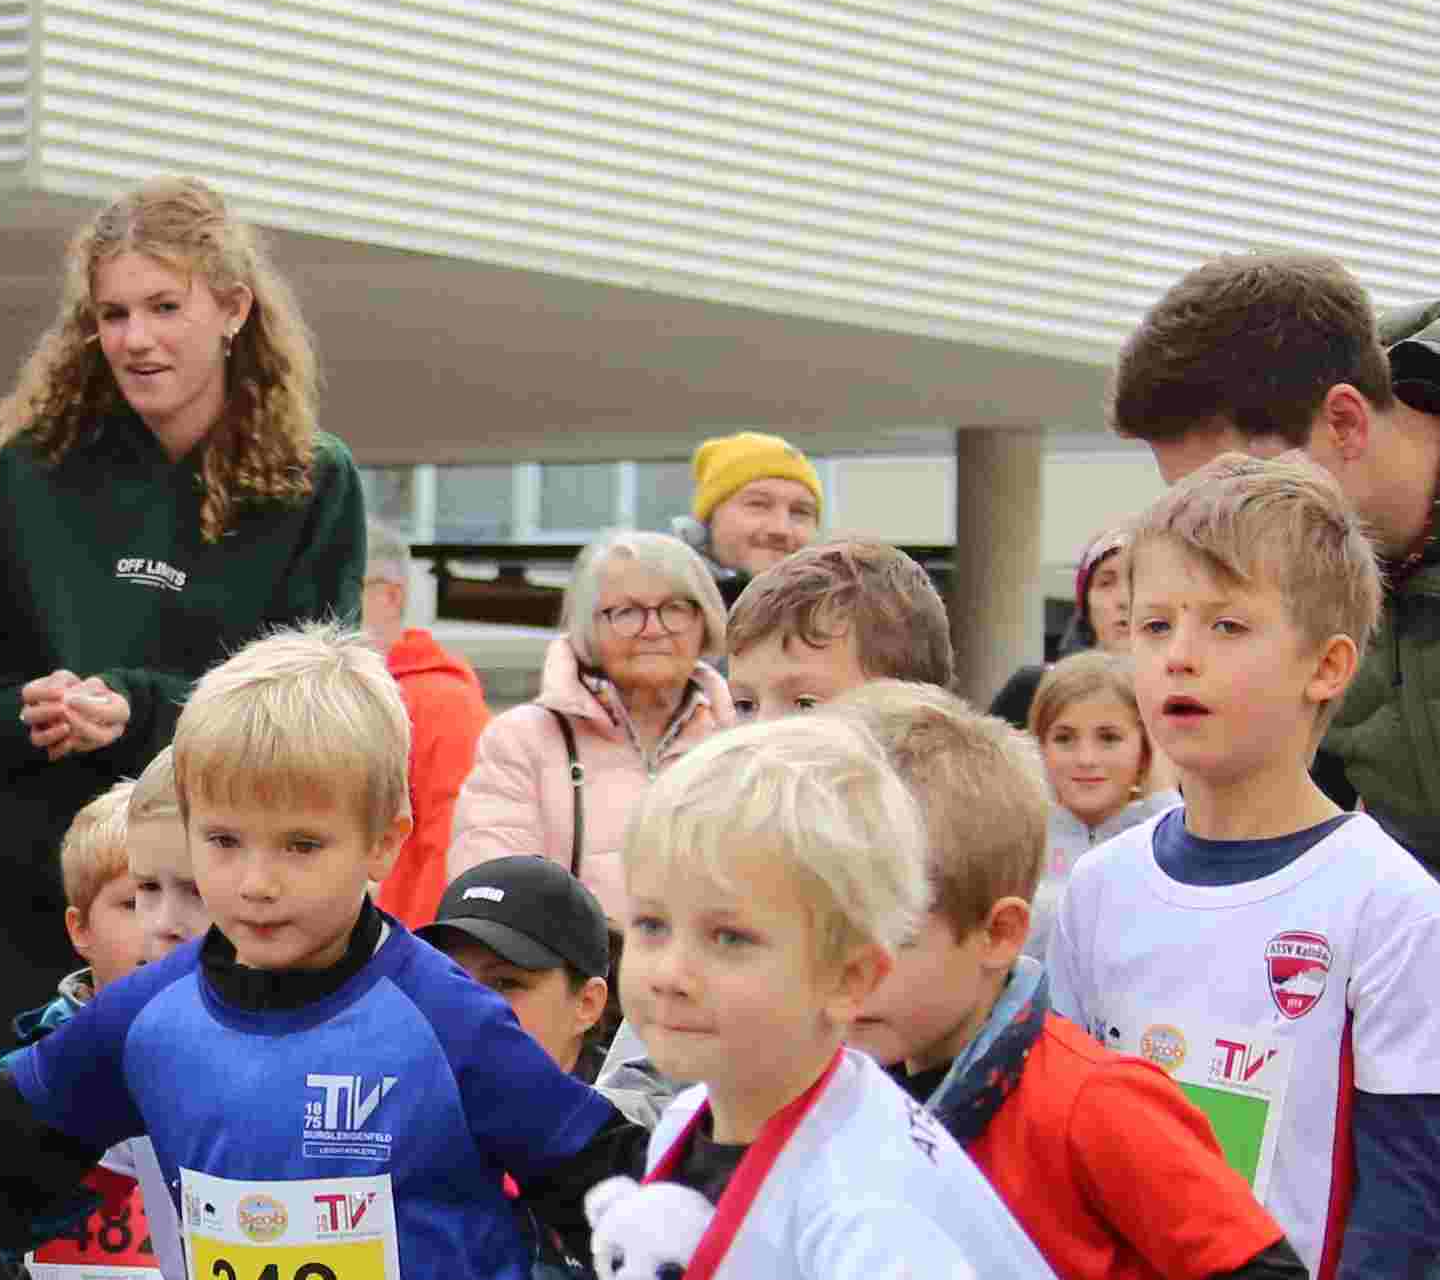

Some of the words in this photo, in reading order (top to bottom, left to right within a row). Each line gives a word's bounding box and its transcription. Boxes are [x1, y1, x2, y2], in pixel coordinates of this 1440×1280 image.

[117, 558, 145, 573] OFF
[304, 1102, 322, 1115] 18
[307, 1074, 399, 1130] TV
[304, 1116, 322, 1129] 75
[313, 1192, 376, 1232] TV
